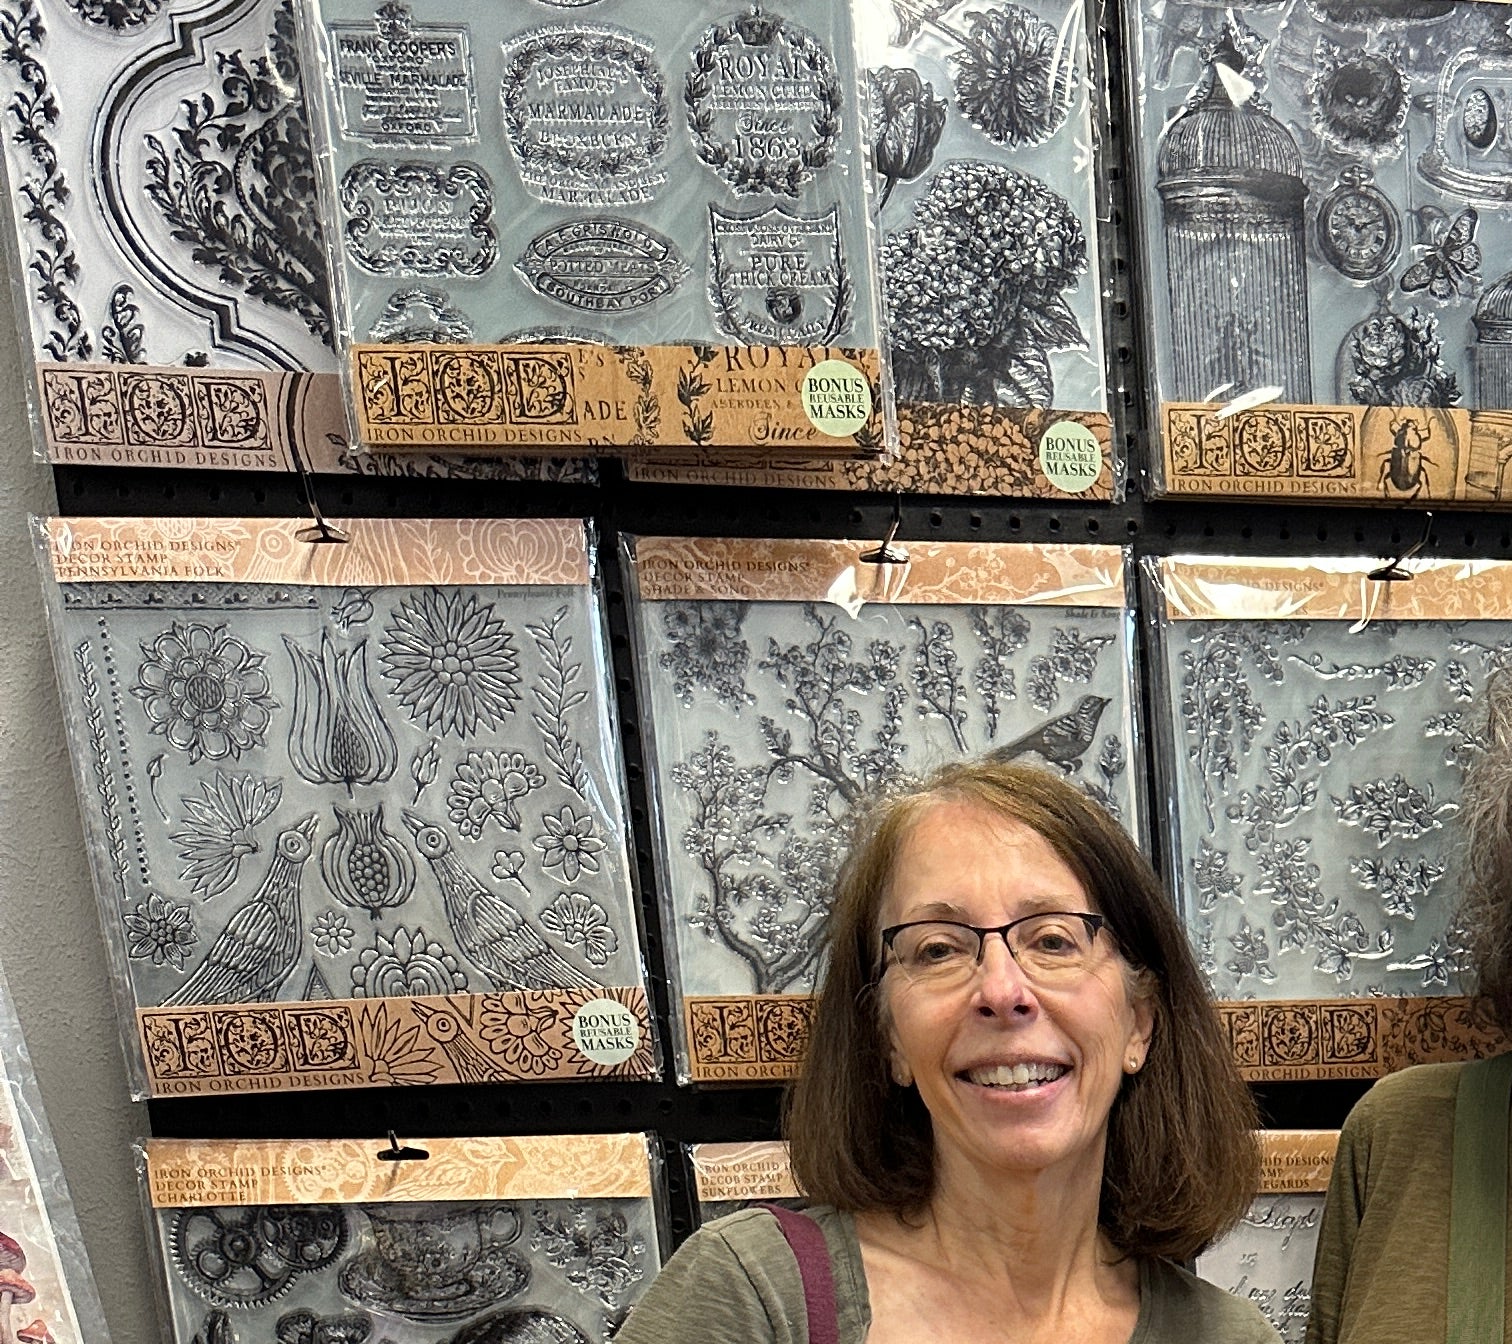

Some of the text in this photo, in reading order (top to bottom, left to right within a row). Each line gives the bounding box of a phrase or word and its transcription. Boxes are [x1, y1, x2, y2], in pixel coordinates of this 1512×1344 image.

[716, 378, 786, 394] LEMON
[808, 377, 864, 393] BONUS
[809, 393, 864, 404] REUSABLE
[810, 404, 866, 419] MASKS
[367, 427, 582, 443] IRON ORCHID DESIGNS
[1046, 436, 1095, 453] BONUS
[54, 446, 278, 468] IRON ORCHID DESIGNS
[1046, 452, 1096, 463] REUSABLE
[1046, 462, 1097, 477] MASKS
[634, 467, 836, 489] IRON ORCHID DESIGNS
[1171, 478, 1357, 495] IRON ORCHID DESIGNS
[117, 553, 168, 565] STAMP
[643, 559, 738, 572] IRON ORCHID
[577, 1013, 632, 1031] BONUS
[580, 1026, 633, 1039] REUSABLE
[580, 1036, 636, 1053] MASKS
[696, 1066, 739, 1078] IRON
[1249, 1067, 1380, 1080] ORCHID DESIGNS
[155, 1073, 365, 1095] IRON ORCHID DESIGNS
[732, 1162, 780, 1174] ORCHID
[1285, 1156, 1338, 1168] DESIGNS
[155, 1168, 256, 1180] IRON ORCHID
[744, 1174, 783, 1185] STAMP
[155, 1180, 258, 1191] DECOR STAMP
[701, 1184, 782, 1198] SUNFLOWERS
[157, 1191, 247, 1204] CHARLOTTE
